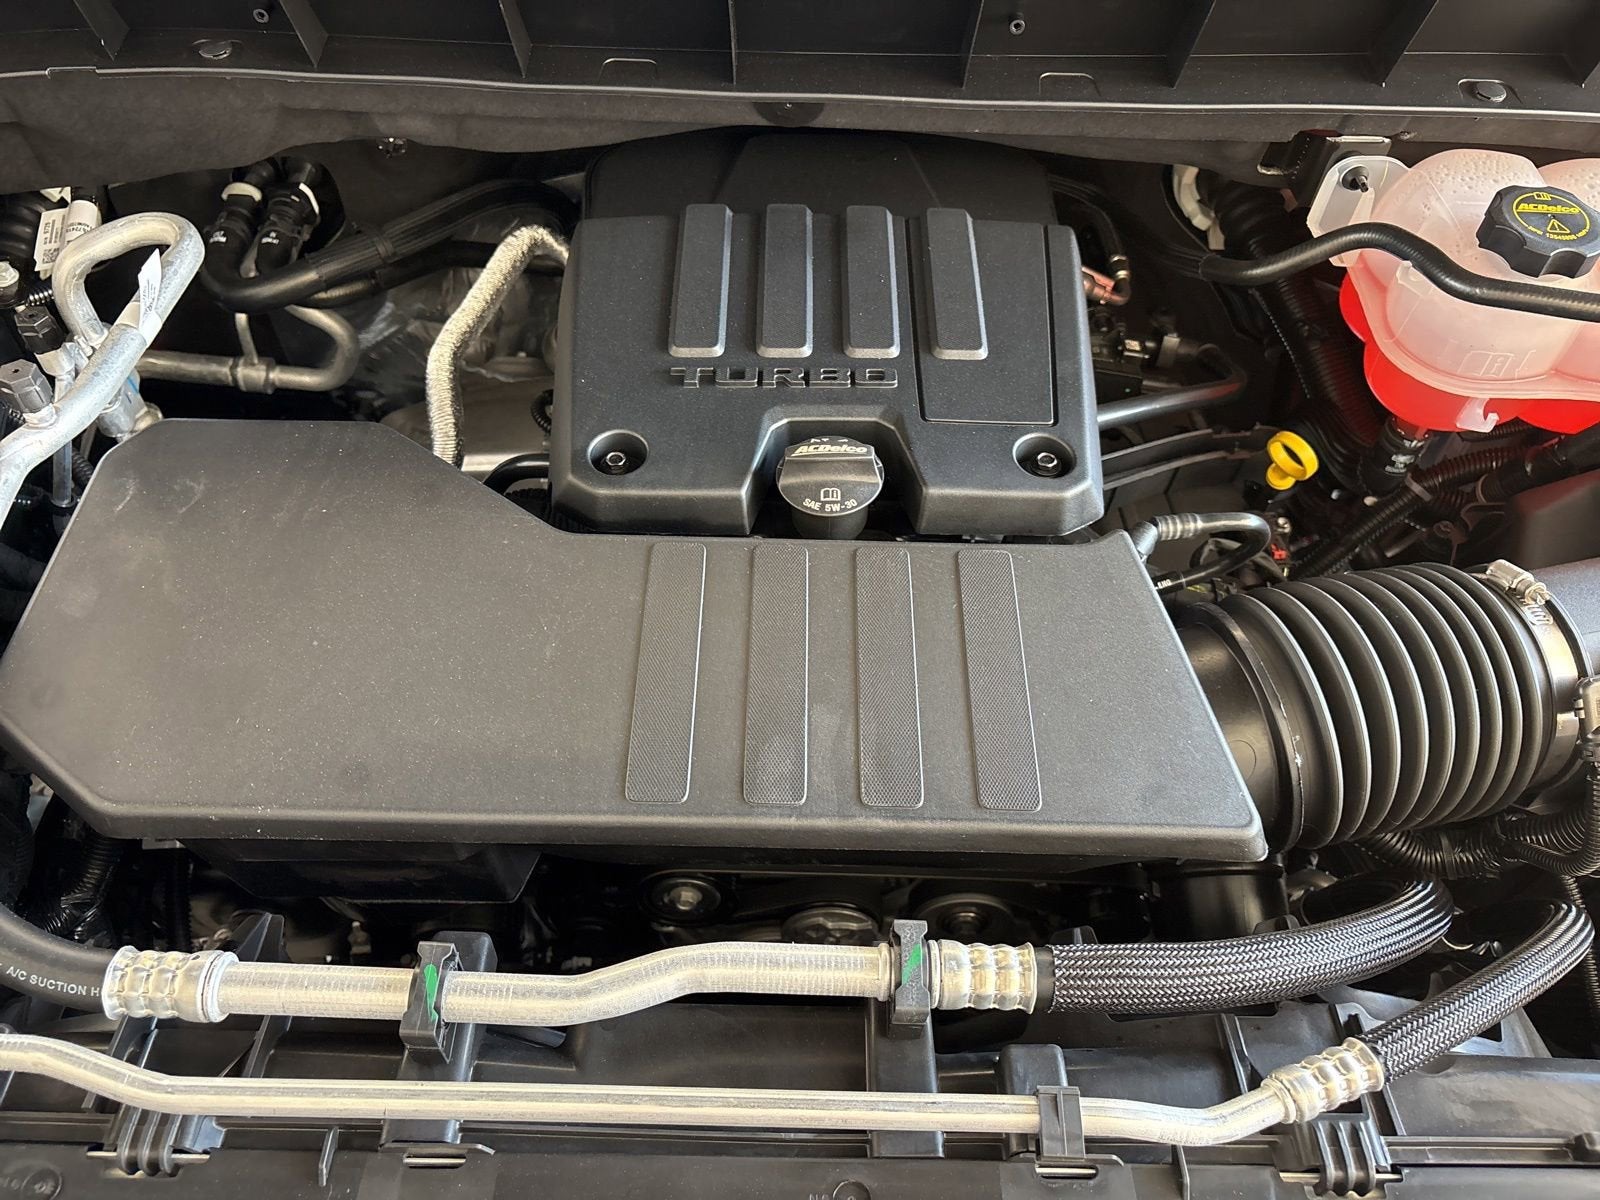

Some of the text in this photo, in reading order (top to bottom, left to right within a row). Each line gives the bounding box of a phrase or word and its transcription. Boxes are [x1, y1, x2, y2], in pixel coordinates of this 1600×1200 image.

[1517, 203, 1580, 213] ACDelco
[670, 367, 898, 388] TURBO
[794, 444, 868, 455] ACDelco
[802, 498, 858, 512] SAE 5W-30
[6, 966, 27, 981] A/C
[29, 974, 87, 996] SUCTION
